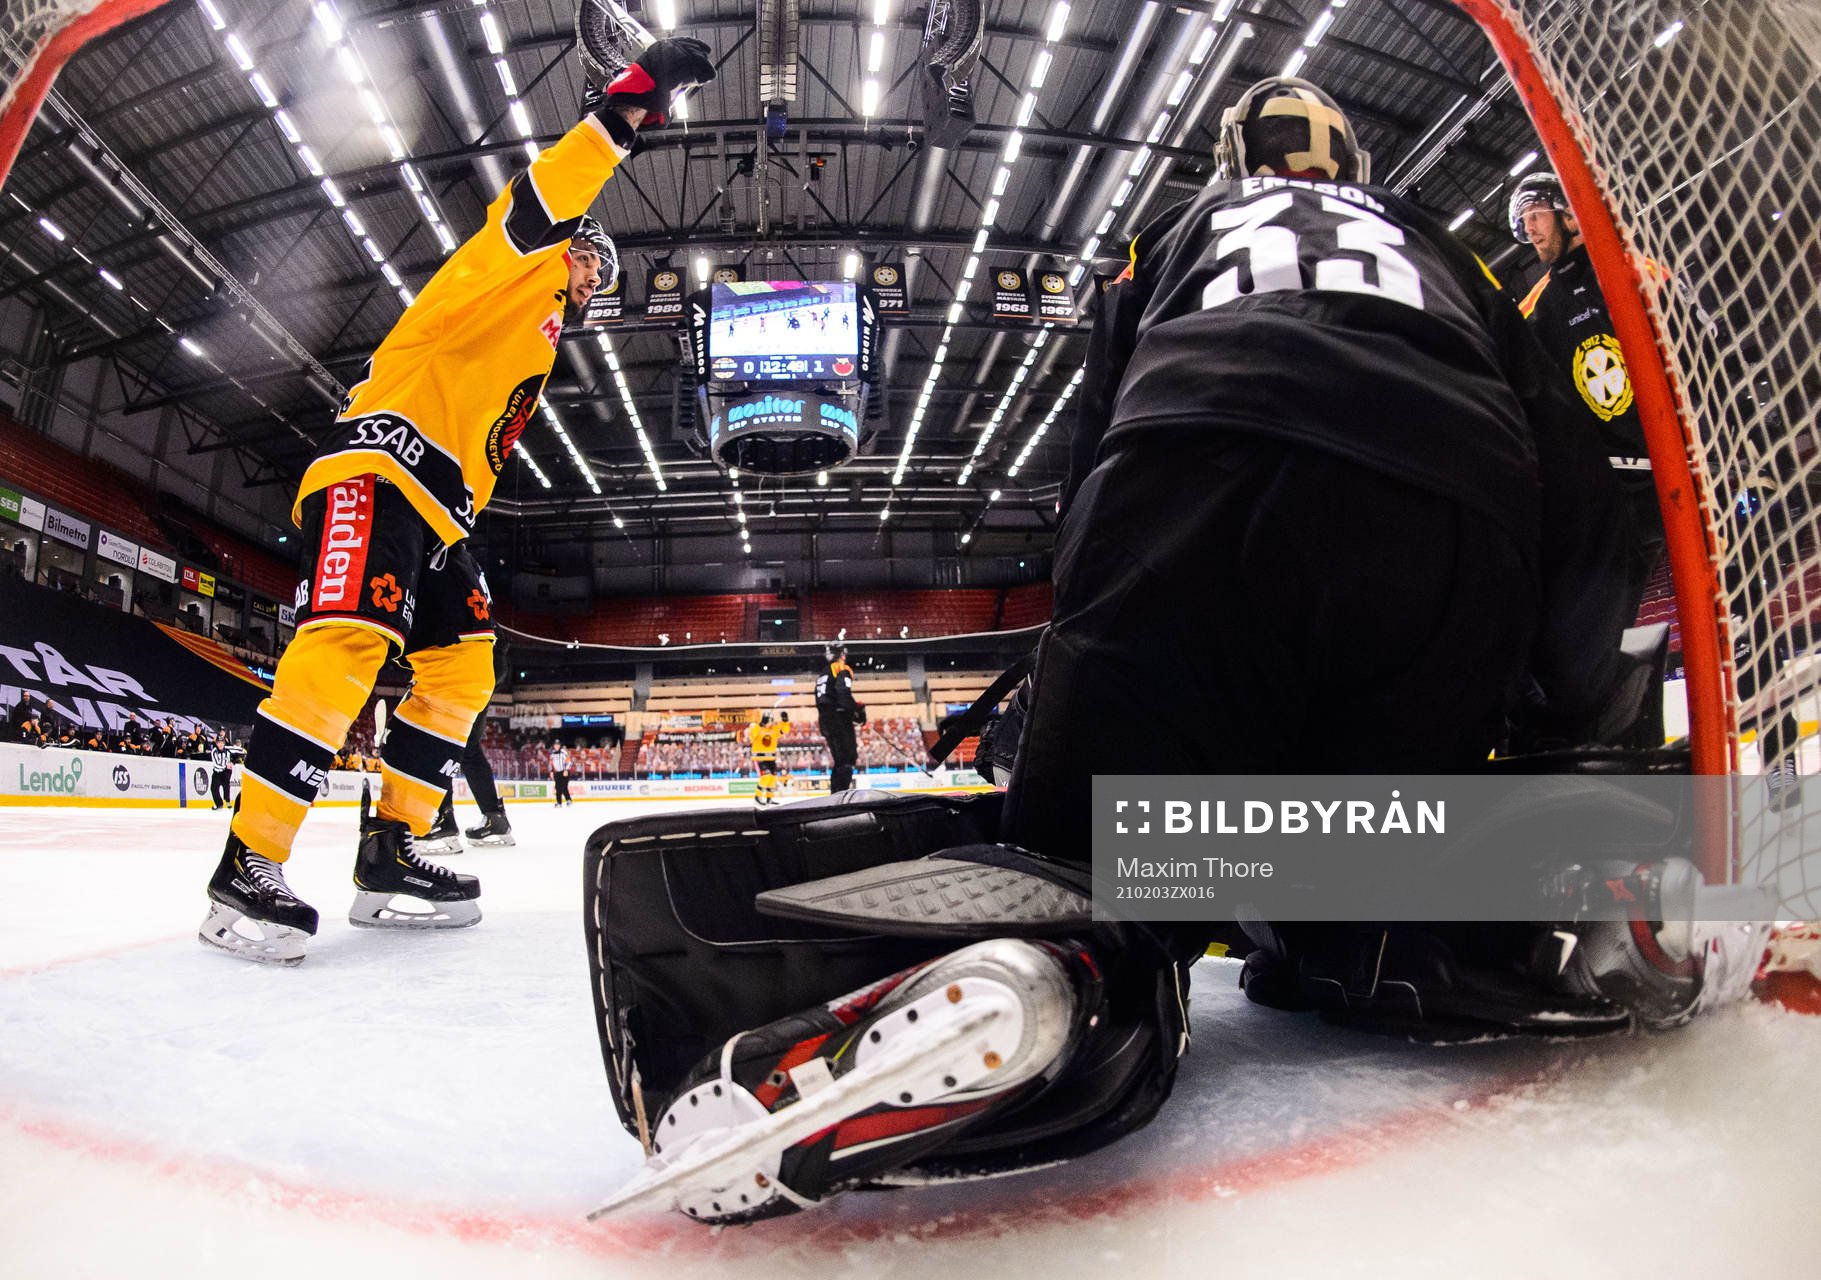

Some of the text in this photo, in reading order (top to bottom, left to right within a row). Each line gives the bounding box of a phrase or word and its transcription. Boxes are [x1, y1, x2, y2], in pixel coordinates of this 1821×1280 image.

[1202, 192, 1424, 310] 33
[647, 303, 682, 313] 1980
[879, 299, 904, 308] 971
[996, 303, 1029, 312] 1968
[1041, 306, 1073, 315] 1967
[586, 308, 622, 318] 1993
[1581, 334, 1601, 350] 1912
[743, 361, 755, 374] 0
[813, 360, 825, 373] 1
[349, 418, 425, 467] SSAB
[48, 515, 87, 543] Bilmetro
[19, 763, 76, 793] Lendo
